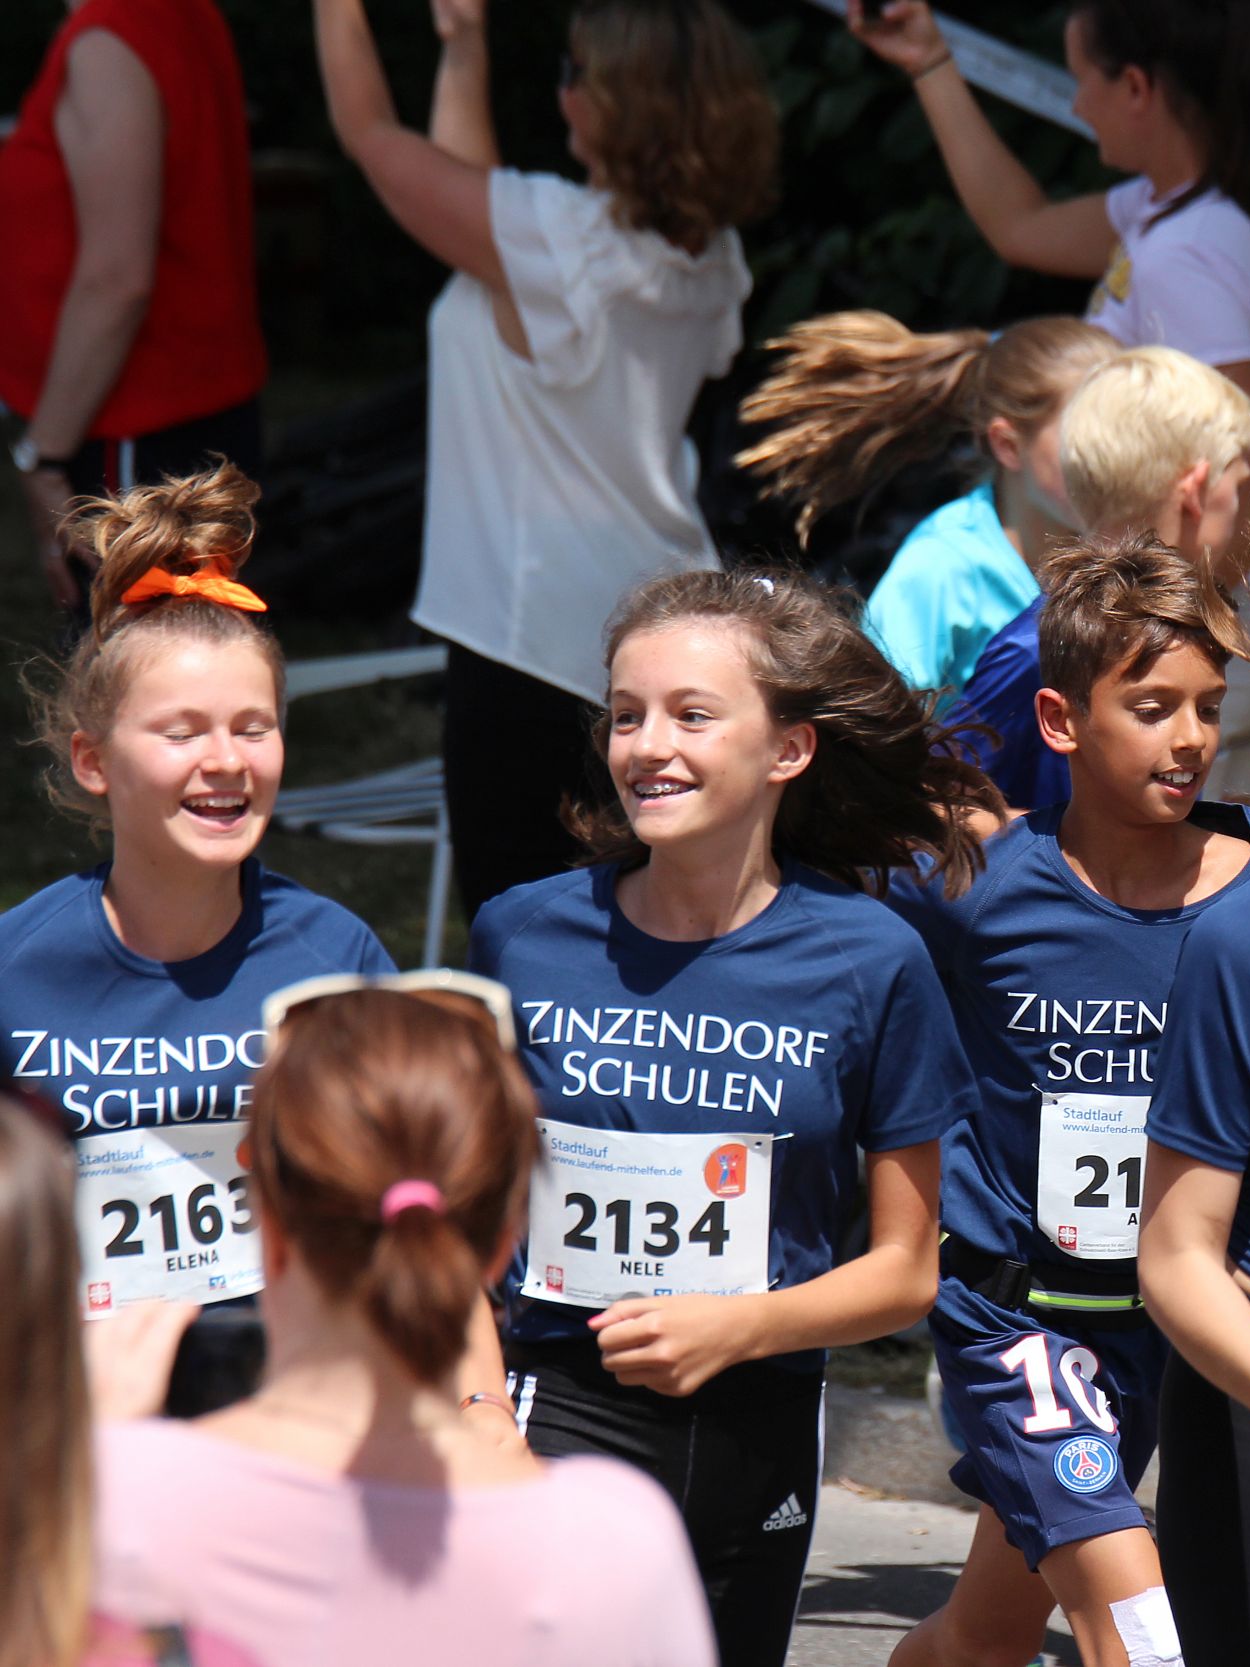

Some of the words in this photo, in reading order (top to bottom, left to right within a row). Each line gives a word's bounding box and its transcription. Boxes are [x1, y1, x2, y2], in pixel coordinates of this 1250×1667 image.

[1007, 992, 1167, 1035] ZINZEN
[522, 1000, 829, 1068] ZINZENDORF
[561, 1050, 783, 1117] SCHULEN
[1063, 1107, 1123, 1122] Stadtlauf
[78, 1145, 144, 1167] Stadtlauf
[551, 1138, 608, 1158] Stadtlauf
[551, 1154, 683, 1177] www.laufend-mithelfen.de
[1074, 1155, 1142, 1208] 21
[101, 1174, 260, 1259] 2163
[563, 1192, 730, 1258] 2134
[167, 1250, 220, 1272] ELENA
[620, 1260, 664, 1277] NELE
[1063, 1442, 1100, 1458] PARIS
[762, 1513, 808, 1532] adidas
